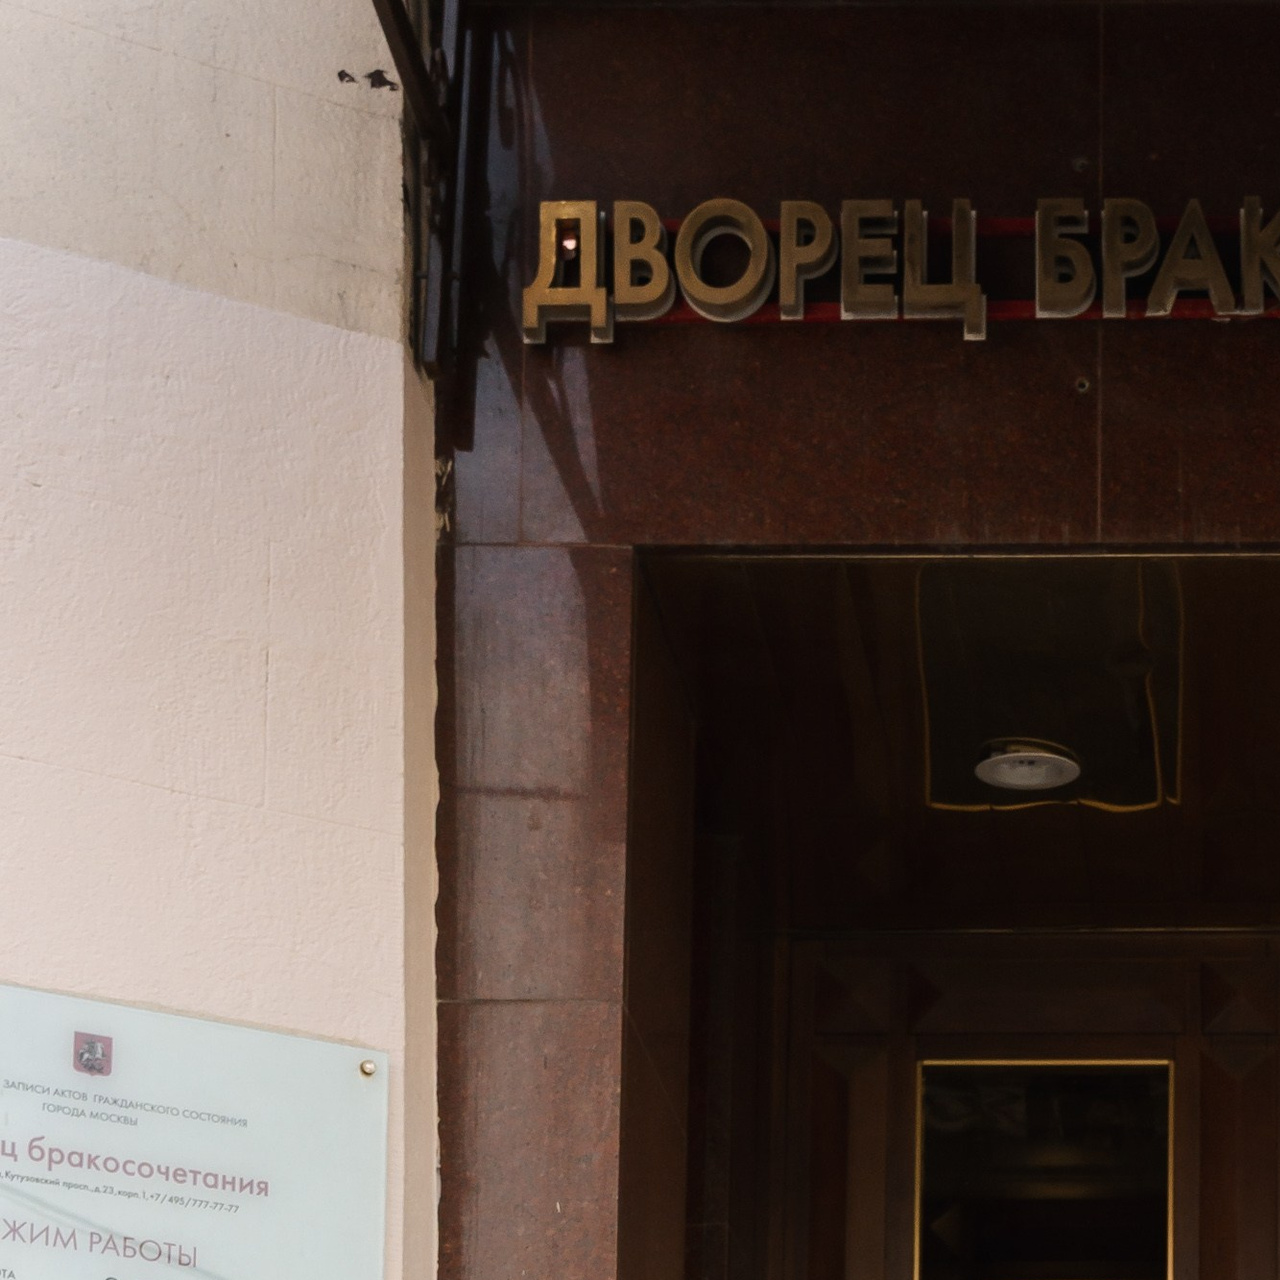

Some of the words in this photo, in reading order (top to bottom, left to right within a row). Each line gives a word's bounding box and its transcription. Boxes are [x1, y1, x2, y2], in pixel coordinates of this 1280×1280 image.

[523, 199, 987, 343] ДВОРЕЦ
[3, 1079, 50, 1095] ЗАПИСИ
[53, 1088, 88, 1101] АКТОВ
[93, 1094, 180, 1116] ГРАЖДАНСКОГО
[182, 1109, 248, 1127] СОСТОЯНИЯ
[42, 1102, 87, 1118] ГОРОДА
[89, 1111, 138, 1126] МОСКВЫ
[28, 1135, 269, 1197] бракосочетания
[2, 1218, 77, 1250] ЖИМ
[88, 1231, 197, 1268] РАБОТЫ
[0, 1268, 16, 1279] ТА
